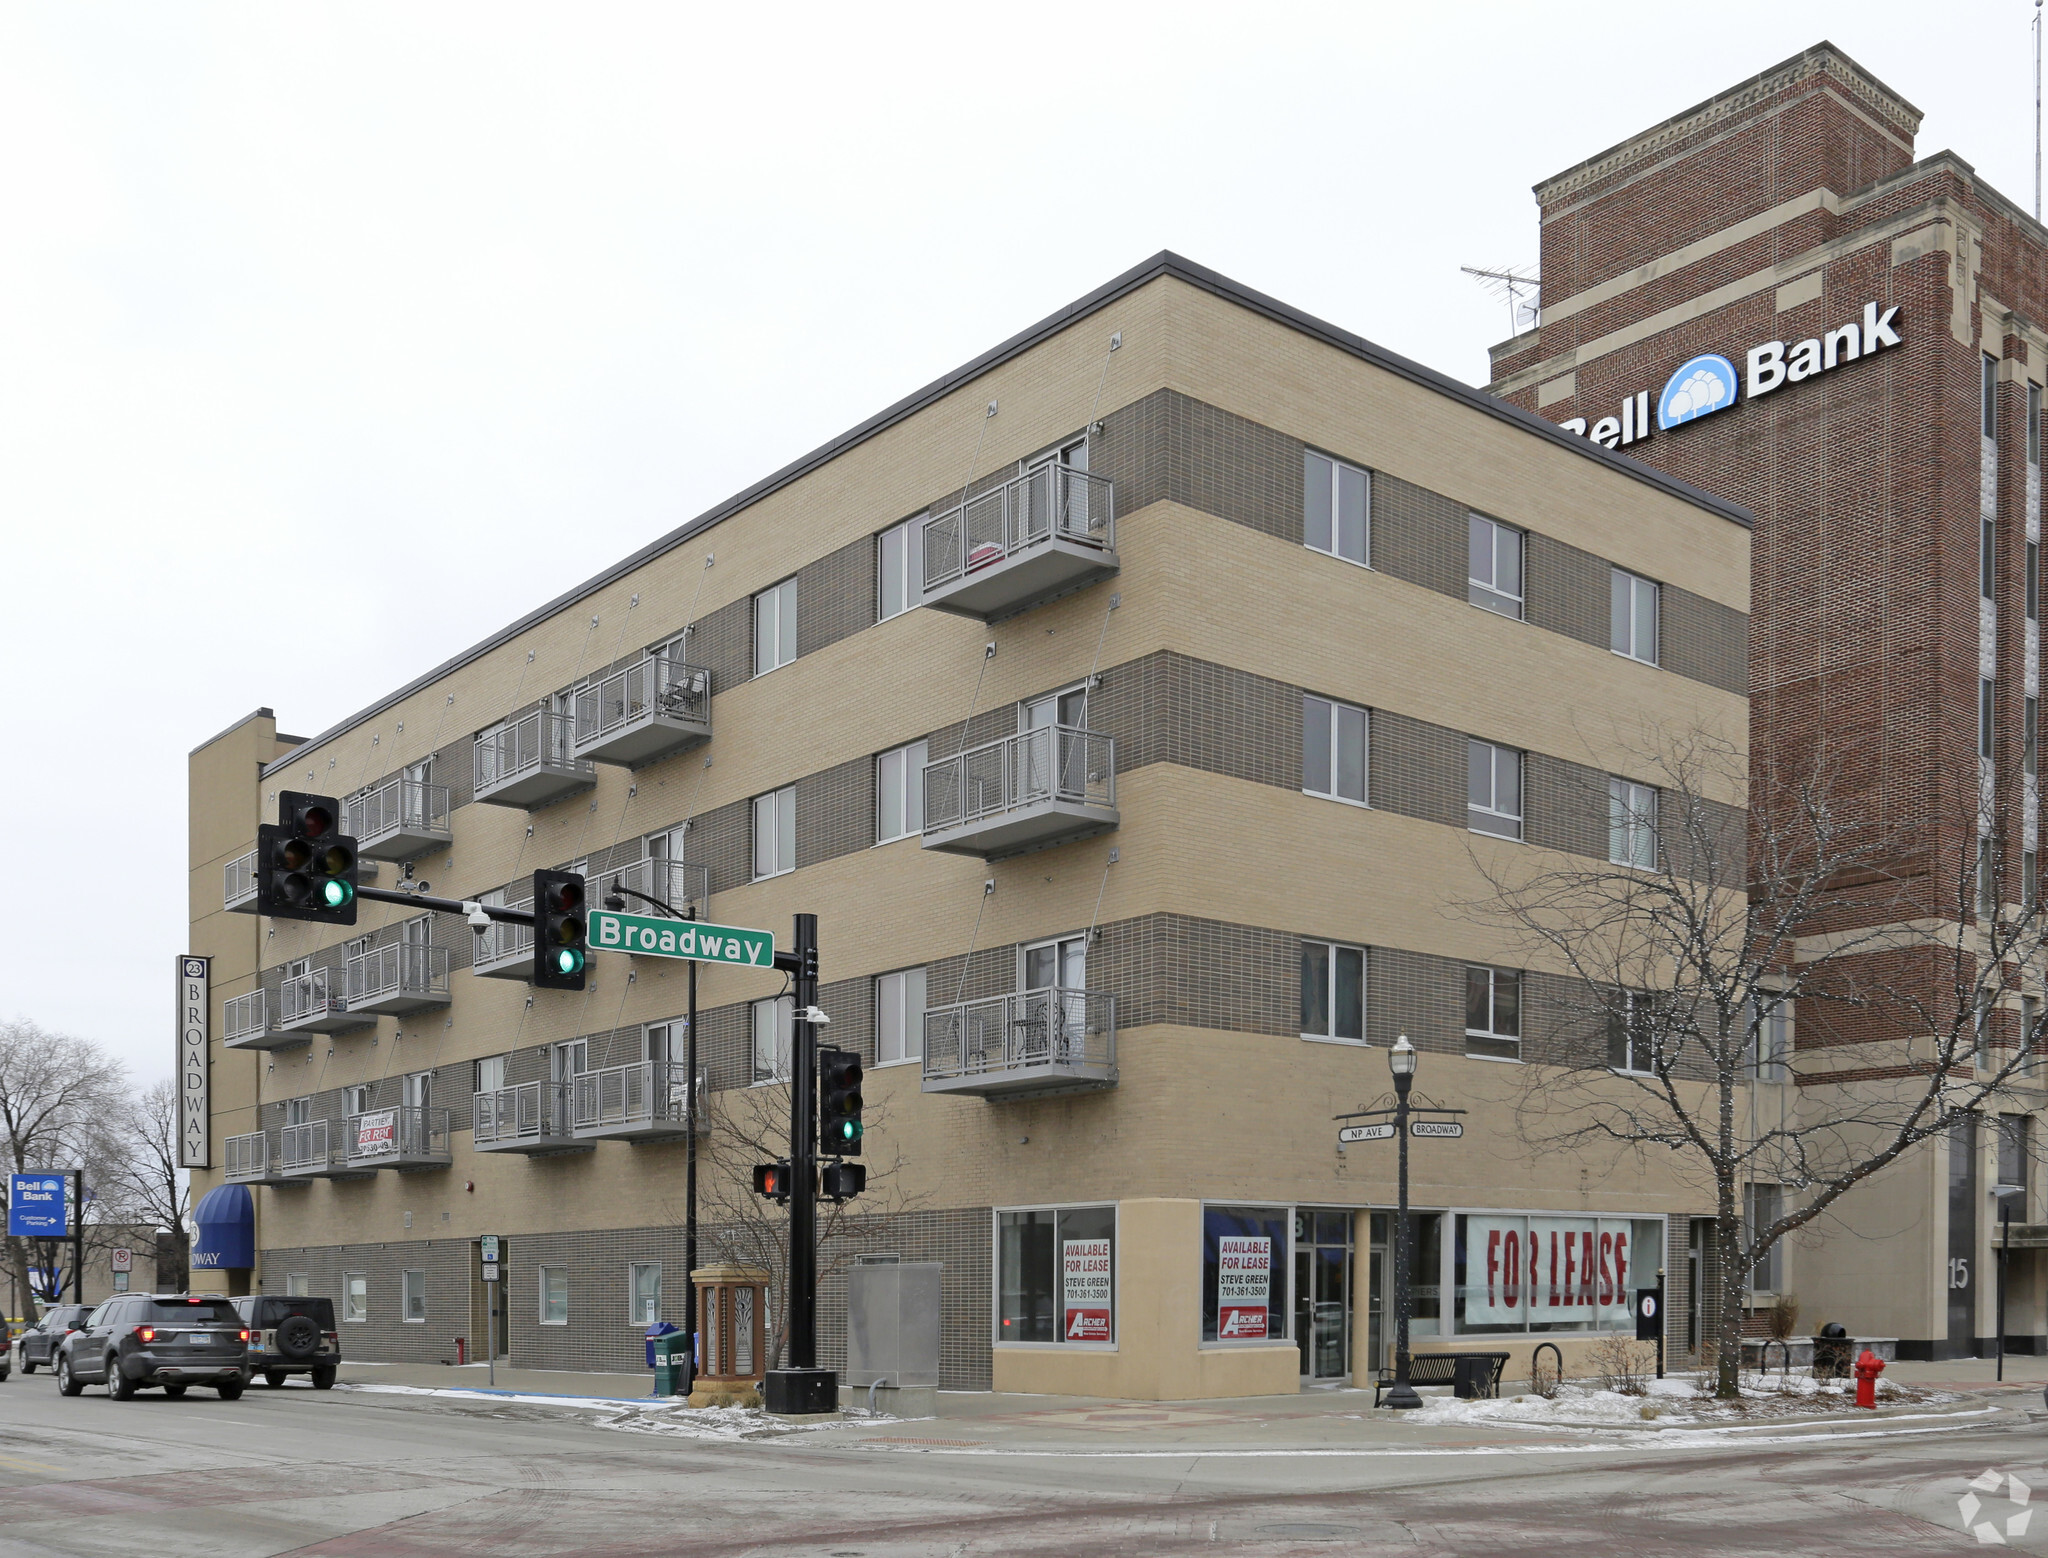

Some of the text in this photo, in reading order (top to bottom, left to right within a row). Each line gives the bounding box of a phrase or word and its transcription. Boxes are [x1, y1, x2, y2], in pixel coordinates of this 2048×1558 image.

[1558, 301, 1901, 449] ell Bank
[600, 916, 763, 965] Broadway
[188, 960, 201, 974] 23
[185, 983, 204, 1158] BROADWAY
[1351, 1127, 1382, 1139] NP AVE
[1416, 1124, 1458, 1134] BROADWAY
[16, 1181, 53, 1200] Bell Bank
[1064, 1244, 1109, 1256] AVAILABLE
[1221, 1241, 1269, 1253] AVAILABLE
[1065, 1260, 1109, 1272] FOR LEASE
[1221, 1257, 1269, 1269] FOR LEASE
[1487, 1230, 1627, 1308] FOR LEASE
[1220, 1274, 1268, 1284] STEVE GREEN
[1948, 1257, 1968, 1289] 15
[1065, 1277, 1109, 1287] STEVE GREEN
[1067, 1289, 1108, 1298] 701-361-3500
[1222, 1286, 1267, 1296] 701-361-3500
[1068, 1312, 1106, 1337] ARCHER
[1221, 1310, 1263, 1335] ARCHER
